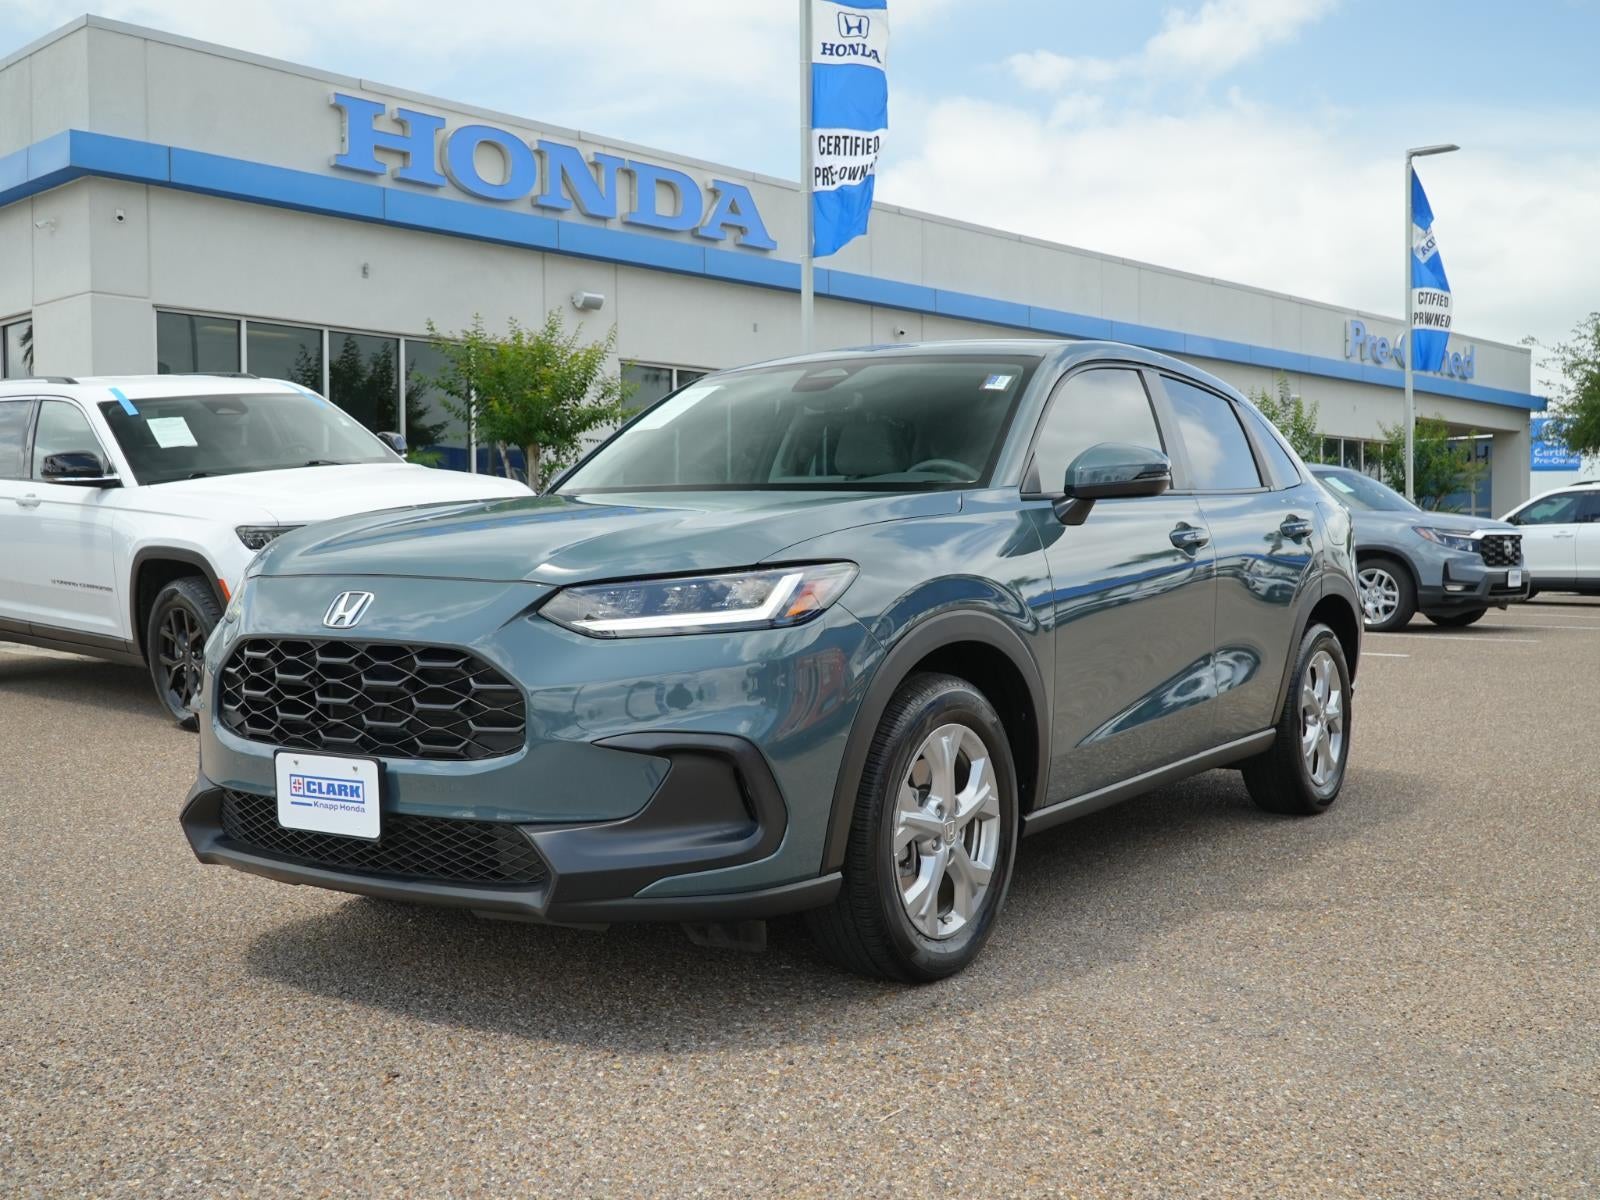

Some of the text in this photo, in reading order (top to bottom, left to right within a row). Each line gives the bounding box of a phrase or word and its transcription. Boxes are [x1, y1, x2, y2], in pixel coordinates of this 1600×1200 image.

[818, 135, 880, 156] CERTIFIED
[330, 92, 777, 251] HONDA
[814, 155, 878, 187] PRE-OWN
[306, 780, 361, 798] CLARK
[313, 801, 366, 813] Knapp Honda
